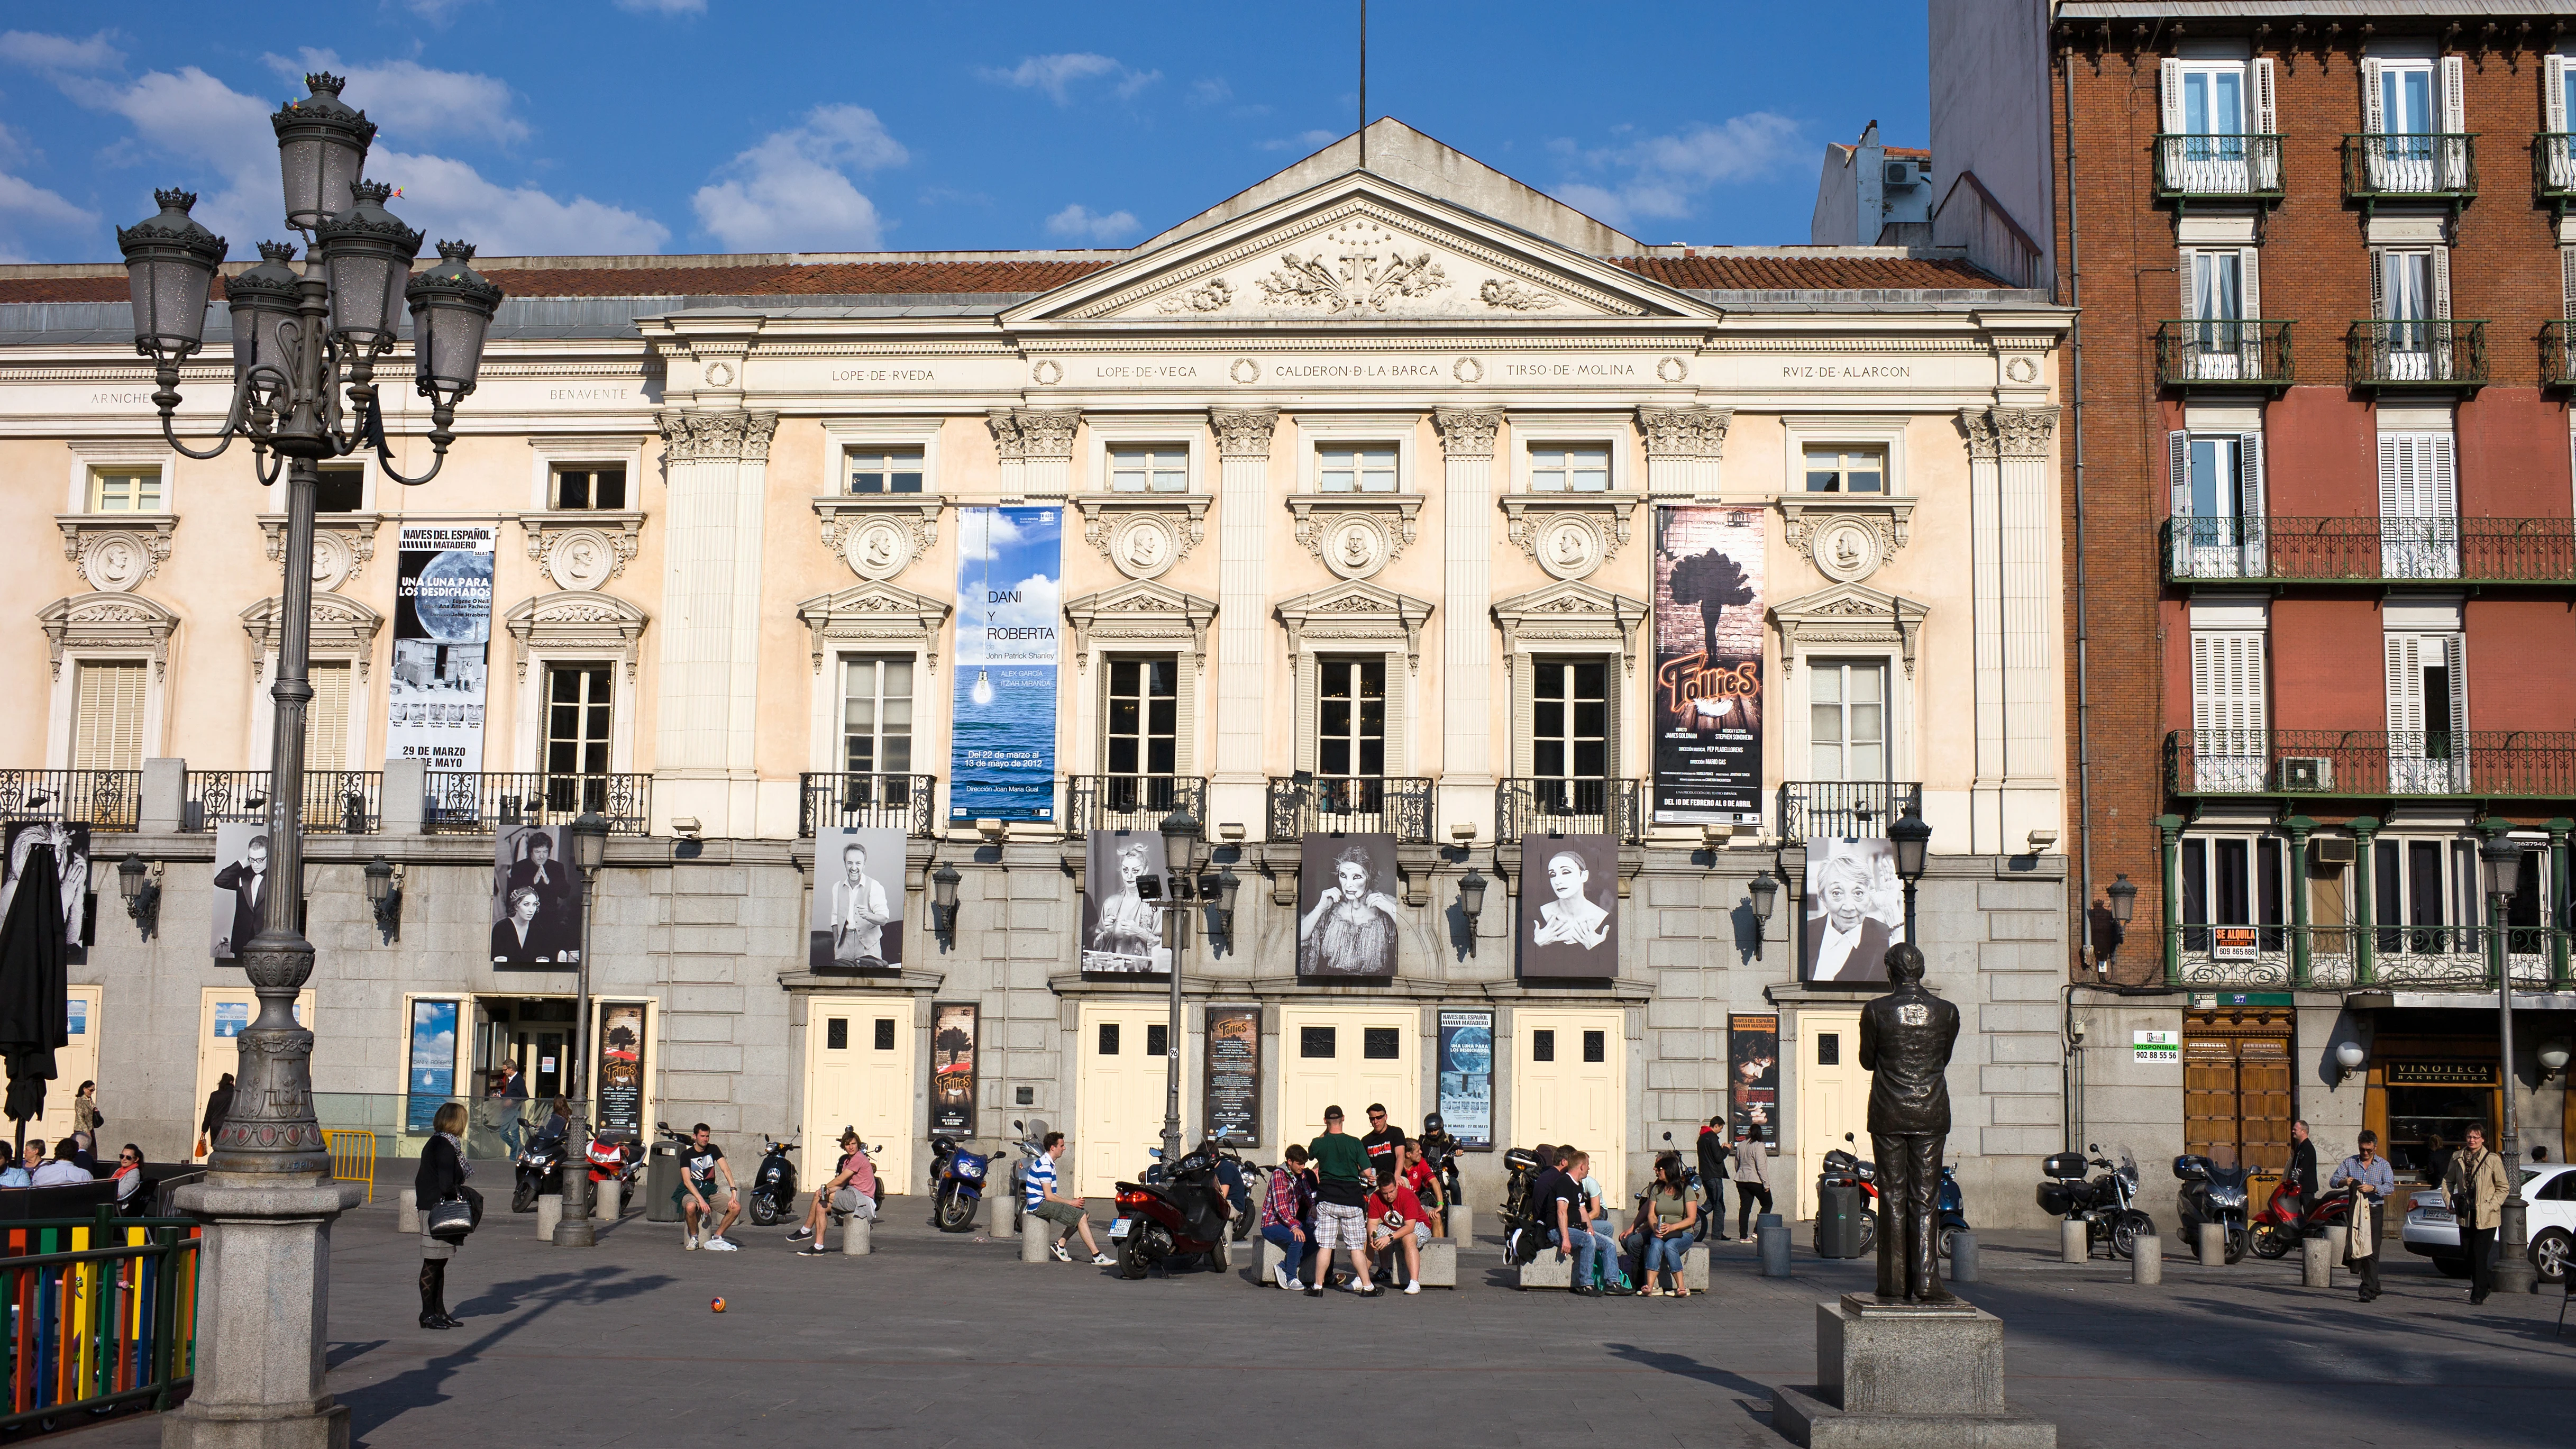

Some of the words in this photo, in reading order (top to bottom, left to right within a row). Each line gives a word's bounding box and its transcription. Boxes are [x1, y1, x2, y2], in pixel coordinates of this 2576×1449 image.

[1097, 367, 1130, 377] LOPE
[1136, 367, 1152, 377] DE
[1159, 366, 1197, 377] VEGA
[1276, 366, 1348, 376] CALDERON
[1368, 366, 1386, 376] LA
[1392, 366, 1439, 376] BARCA
[1506, 364, 1547, 375] TIRSO
[1554, 365, 1570, 375] DE
[1577, 365, 1635, 375] MOLINA
[1783, 367, 1813, 377] RVIZ
[1819, 367, 1836, 377] DE
[1843, 367, 1910, 377] ALARCON
[833, 371, 864, 381] LOPE
[871, 370, 887, 380] DE
[893, 370, 935, 380] RVEDA
[551, 389, 628, 399] BENAVENTE
[404, 530, 433, 540] NAVES
[434, 530, 450, 540] DEL
[451, 528, 491, 540] ESPAÑOL
[434, 541, 477, 549] MATADERO
[402, 577, 425, 587] UNA
[427, 577, 455, 587] LUNA
[459, 578, 489, 587] PARA
[399, 587, 418, 596] LOS
[421, 587, 491, 597] DESDICHADOS
[988, 591, 1021, 603] DANI
[988, 611, 996, 622] Y
[987, 627, 1055, 640] ROBERTA
[1660, 652, 1759, 712] Follies
[403, 746, 414, 755] 29
[418, 746, 430, 755] DE
[433, 747, 465, 757] MARZO
[435, 758, 462, 768] MAYO
[2216, 929, 2225, 939] SE
[2227, 929, 2255, 940] ALQUILA
[1218, 1019, 1247, 1037] Follies
[2147, 1033, 2165, 1041] Retail
[605, 1061, 637, 1081] Follies
[935, 1072, 972, 1095] Follies
